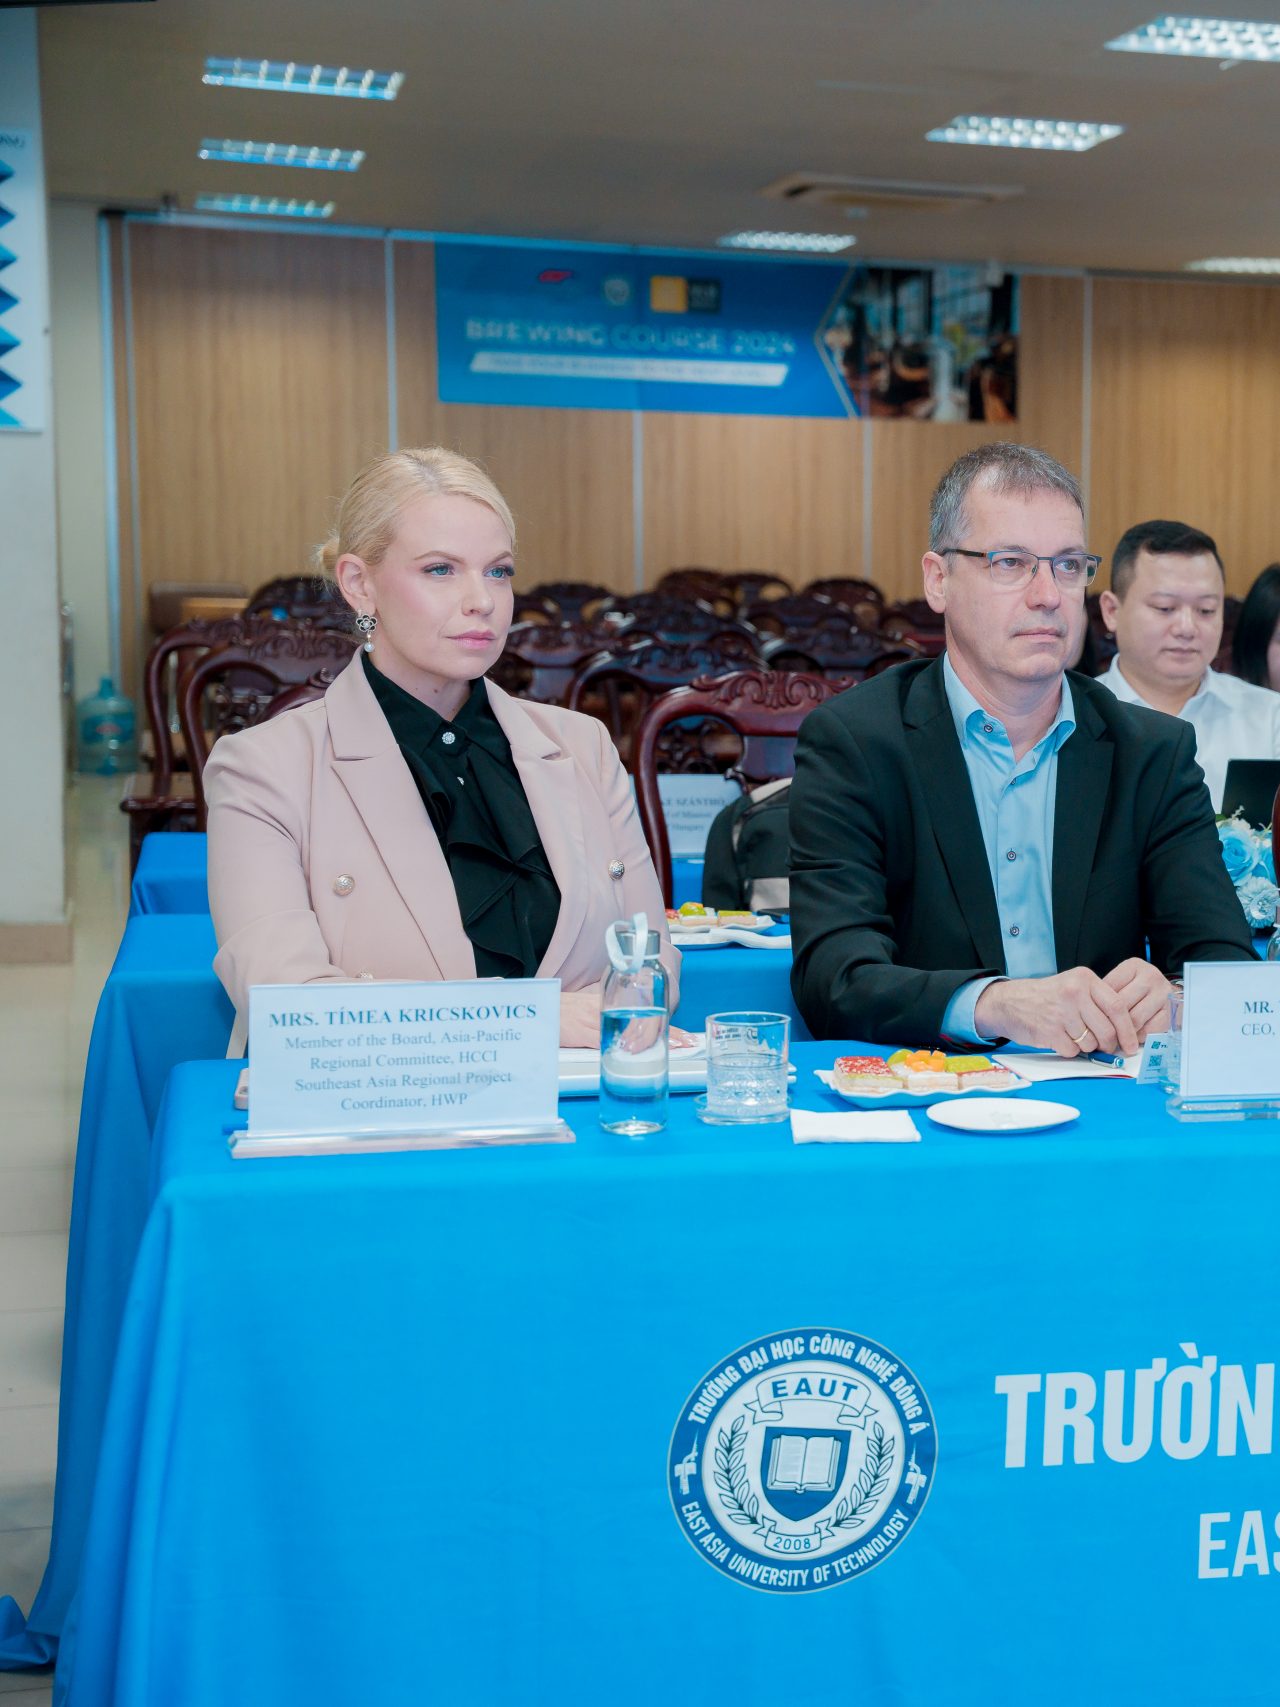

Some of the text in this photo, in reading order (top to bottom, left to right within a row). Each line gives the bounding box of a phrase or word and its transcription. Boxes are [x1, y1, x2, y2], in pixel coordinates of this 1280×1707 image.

[611, 323, 719, 351] COURSE
[268, 1004, 537, 1028] MRS. TÍMEA KRICSKOVICS
[1243, 1000, 1274, 1014] MR.
[284, 1028, 522, 1050] Member of the Board, Asia-Pacific
[1242, 1024, 1276, 1036] CEO,
[310, 1050, 497, 1072] Regional Committee, HCCI
[295, 1071, 512, 1091] Southeast Asia Regional Project
[341, 1093, 468, 1112] Coordinator, HWP
[689, 1333, 930, 1435] TRƯỜNG ĐẠI HỌC CÔNG NGHỆ ĐÔNG Á
[772, 1378, 858, 1401] EAUT
[681, 1501, 909, 1587] EAST ASIA UNIVERSITY OF TECHNOLOGY
[773, 1536, 811, 1549] 2008
